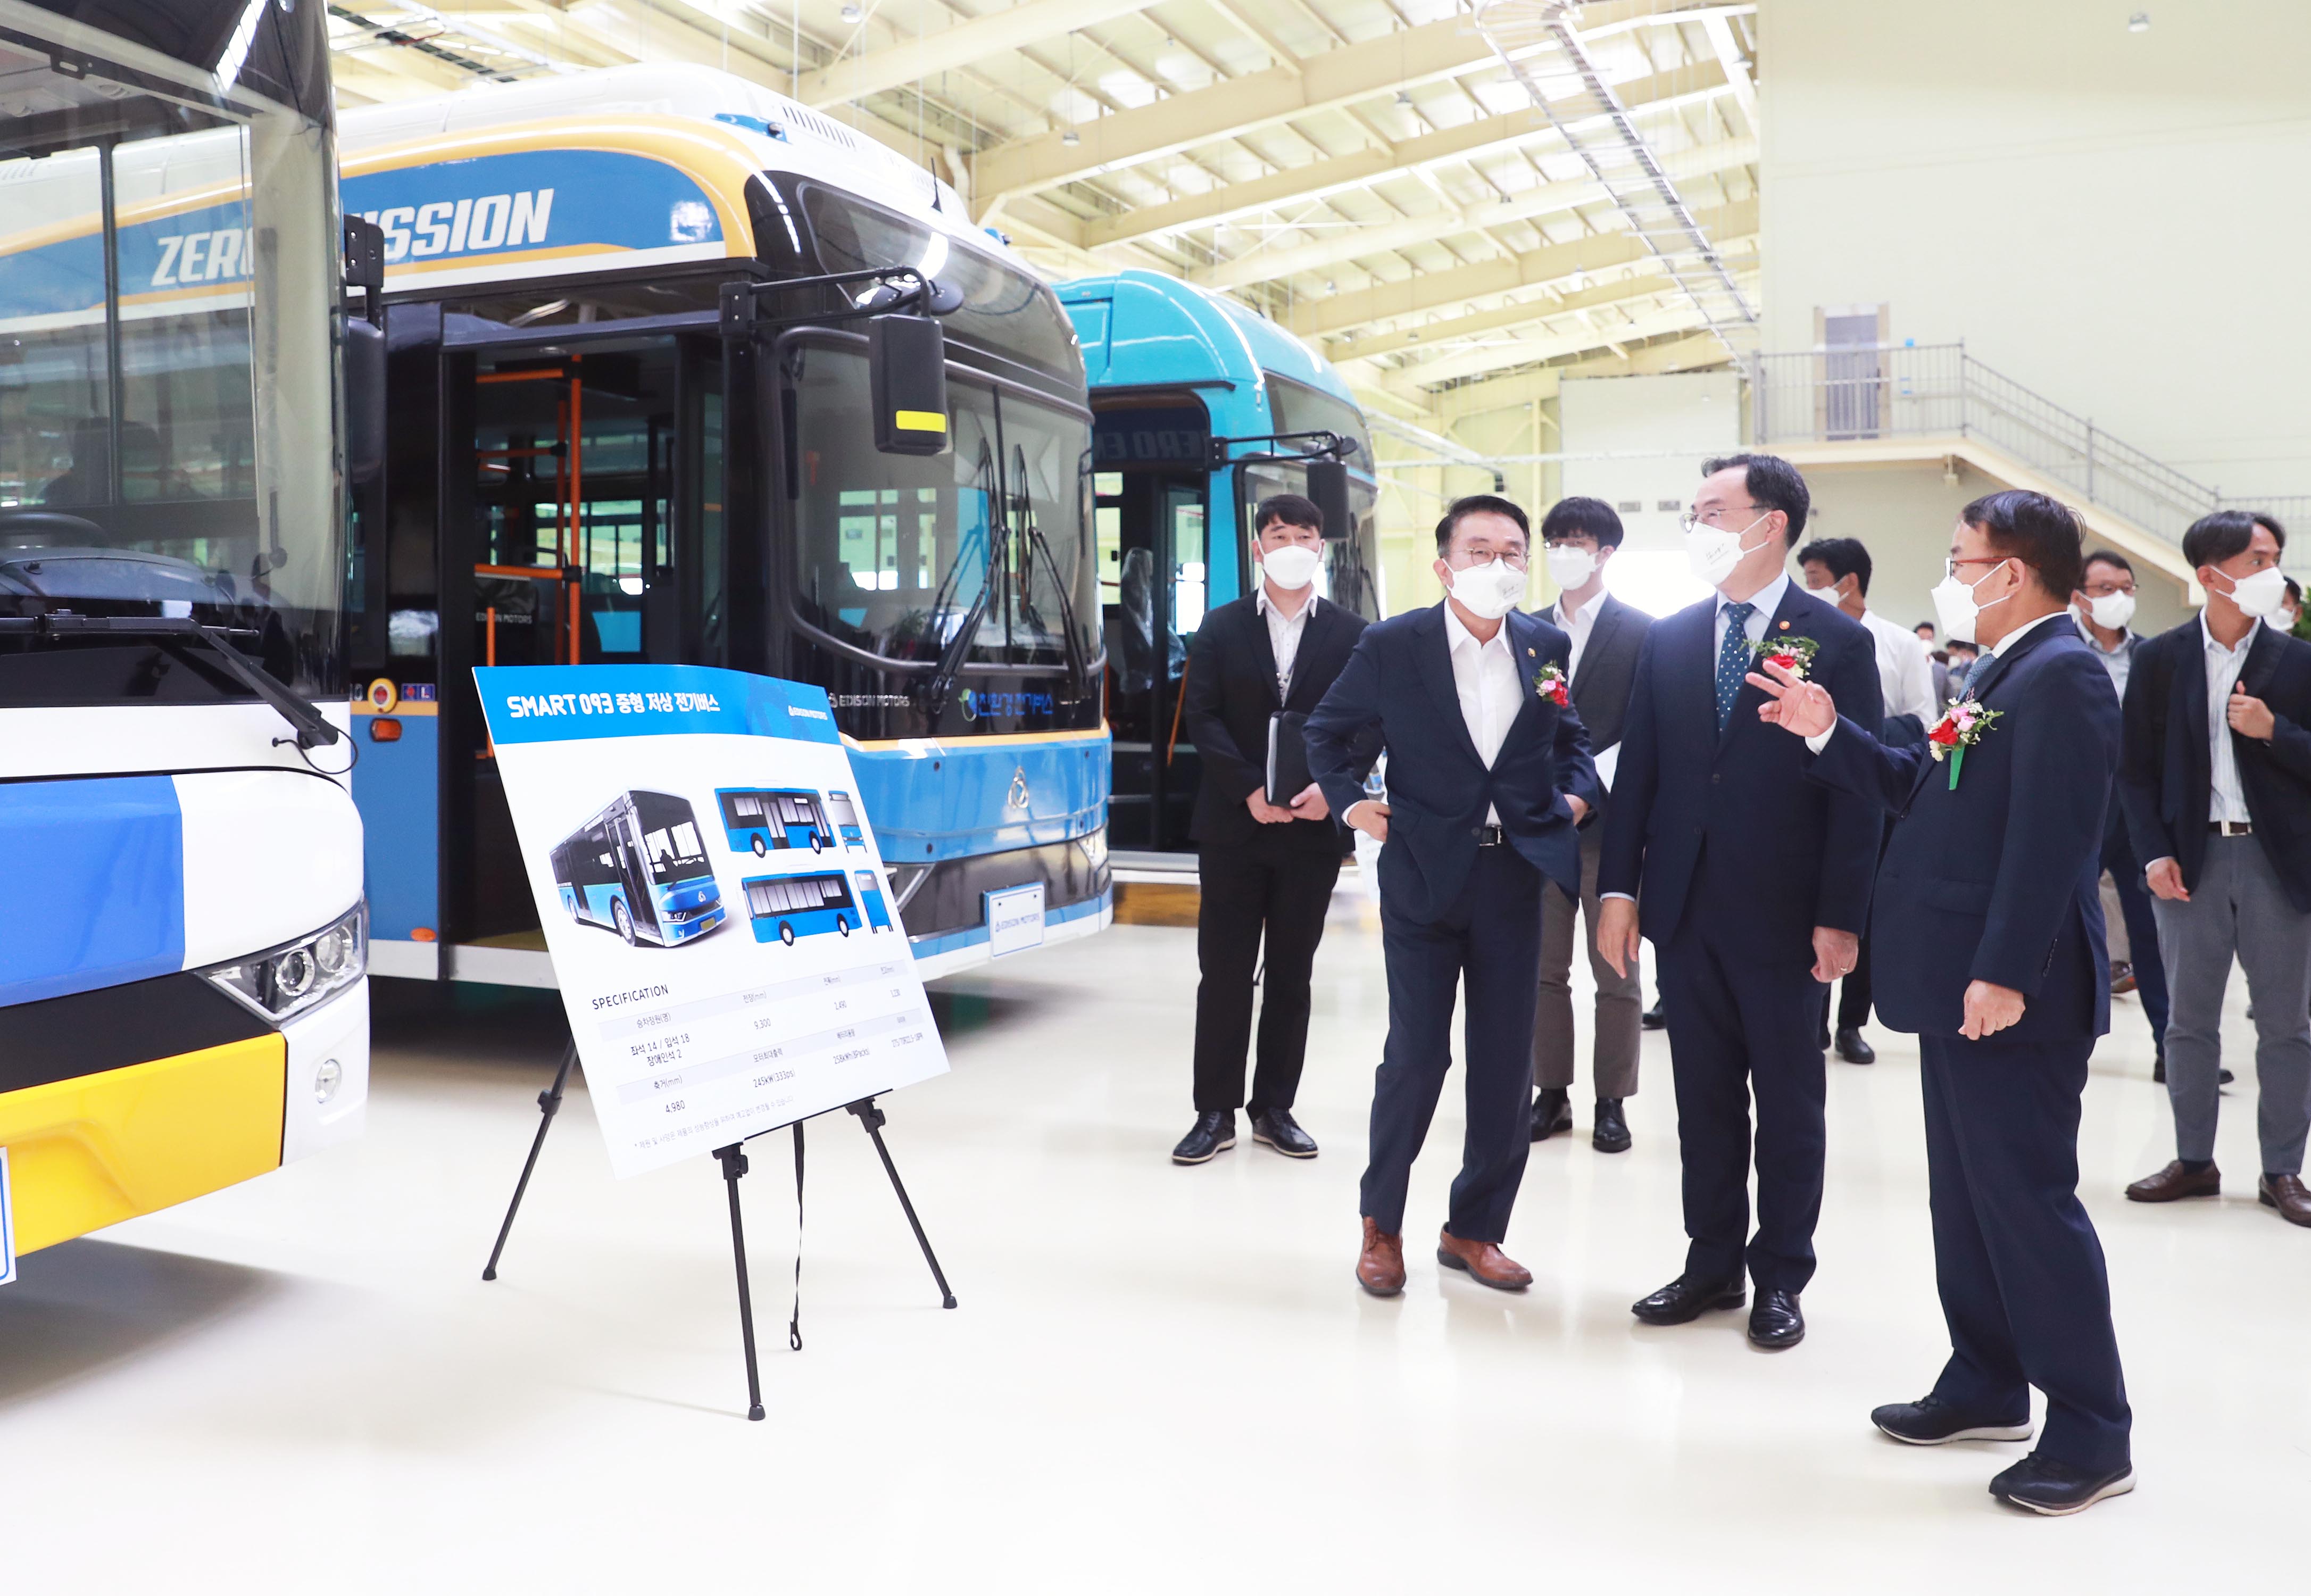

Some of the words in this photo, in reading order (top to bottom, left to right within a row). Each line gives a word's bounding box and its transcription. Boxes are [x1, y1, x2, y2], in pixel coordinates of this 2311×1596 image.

[506, 694, 576, 718] SMART
[579, 693, 614, 715] 093
[616, 692, 645, 713] 중형
[645, 692, 674, 712] 저상
[674, 692, 721, 712] 전기버스
[839, 695, 876, 707] EDISON
[876, 695, 910, 707] MOTORS
[592, 984, 669, 1010] SPECIFICATION
[636, 1012, 671, 1028] 승차정원(명)
[630, 1043, 646, 1055] 좌석
[647, 1041, 657, 1052] 14
[664, 1035, 679, 1048] 입석
[681, 1033, 690, 1043] 18
[647, 1052, 675, 1067] 장애인석
[676, 1049, 682, 1058] 2
[654, 1074, 683, 1090] 축거(mm)
[753, 1068, 795, 1087] 245kW(333ps)
[666, 1100, 685, 1113] 4,980
